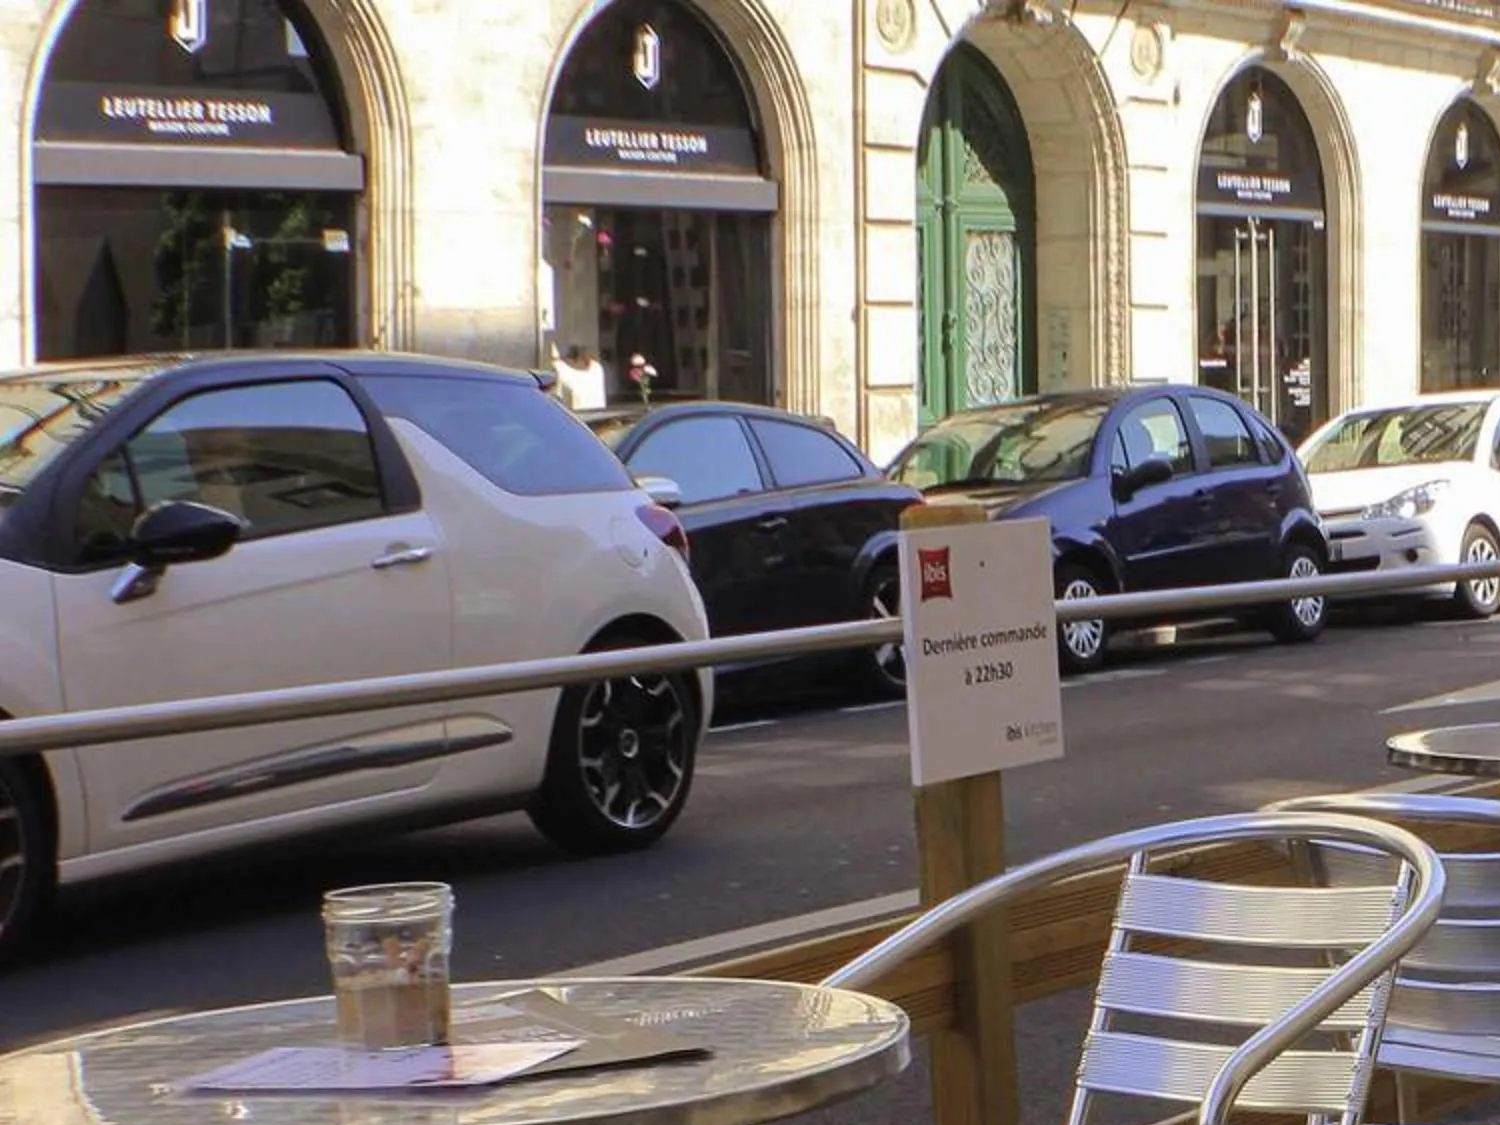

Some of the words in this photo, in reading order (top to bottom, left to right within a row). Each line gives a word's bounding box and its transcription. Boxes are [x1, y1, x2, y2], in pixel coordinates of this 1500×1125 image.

[924, 561, 946, 583] ibis
[923, 632, 977, 656] Dernière
[981, 623, 1047, 648] commande
[964, 667, 972, 686] à
[975, 661, 1013, 684] 22h30
